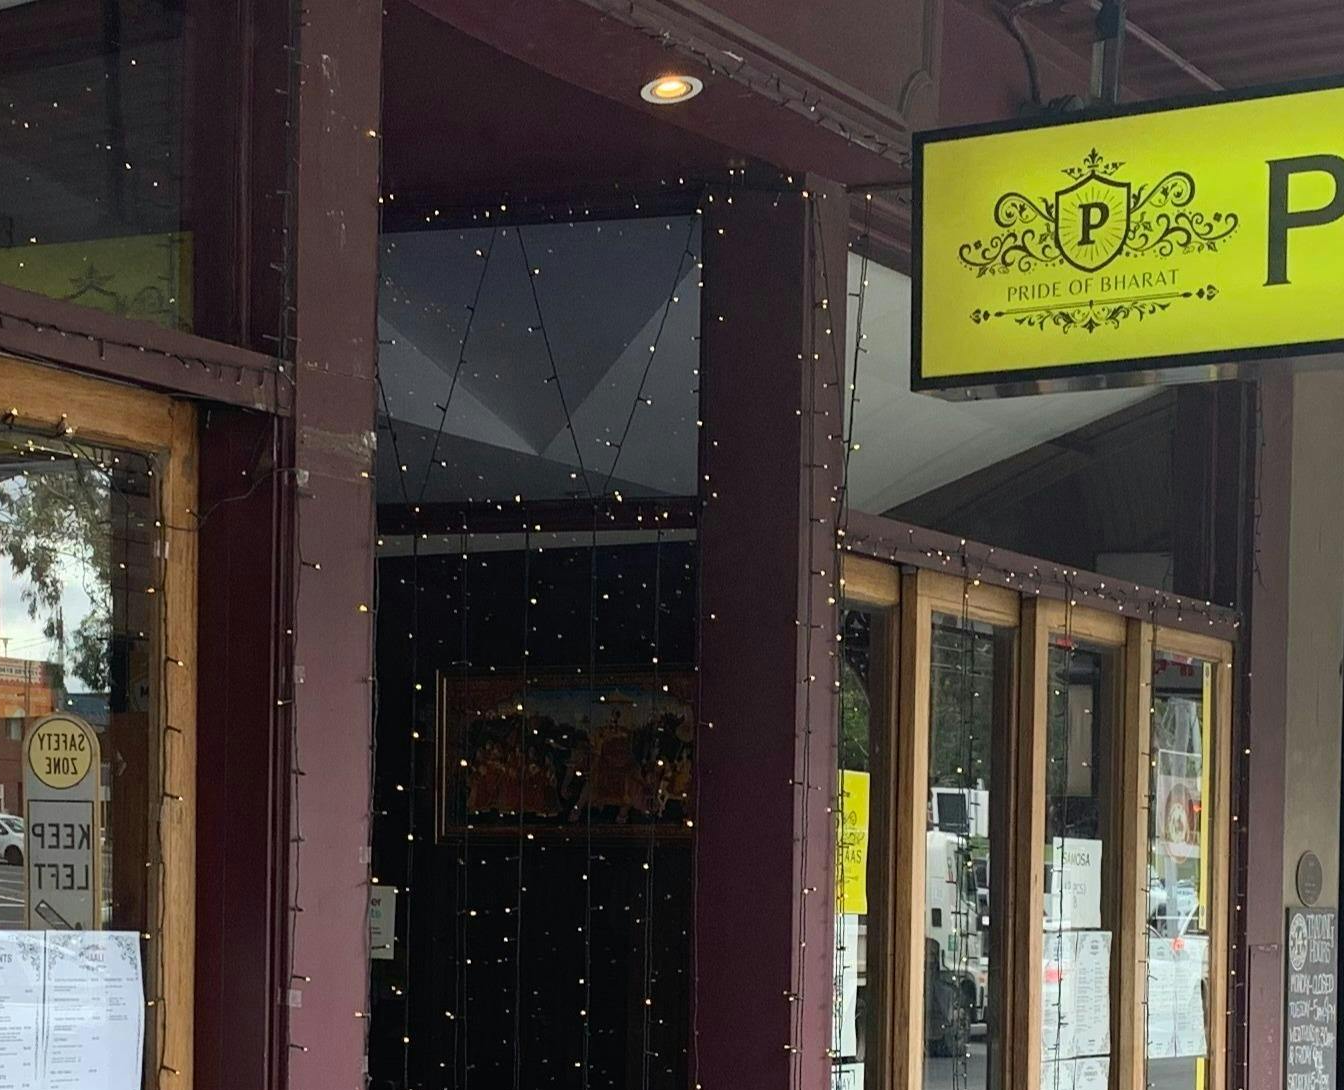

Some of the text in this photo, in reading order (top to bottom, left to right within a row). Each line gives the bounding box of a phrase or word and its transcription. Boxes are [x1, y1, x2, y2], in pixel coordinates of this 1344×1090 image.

[1077, 201, 1110, 247] P
[1007, 269, 1180, 302] PRIDE OF BHARAT
